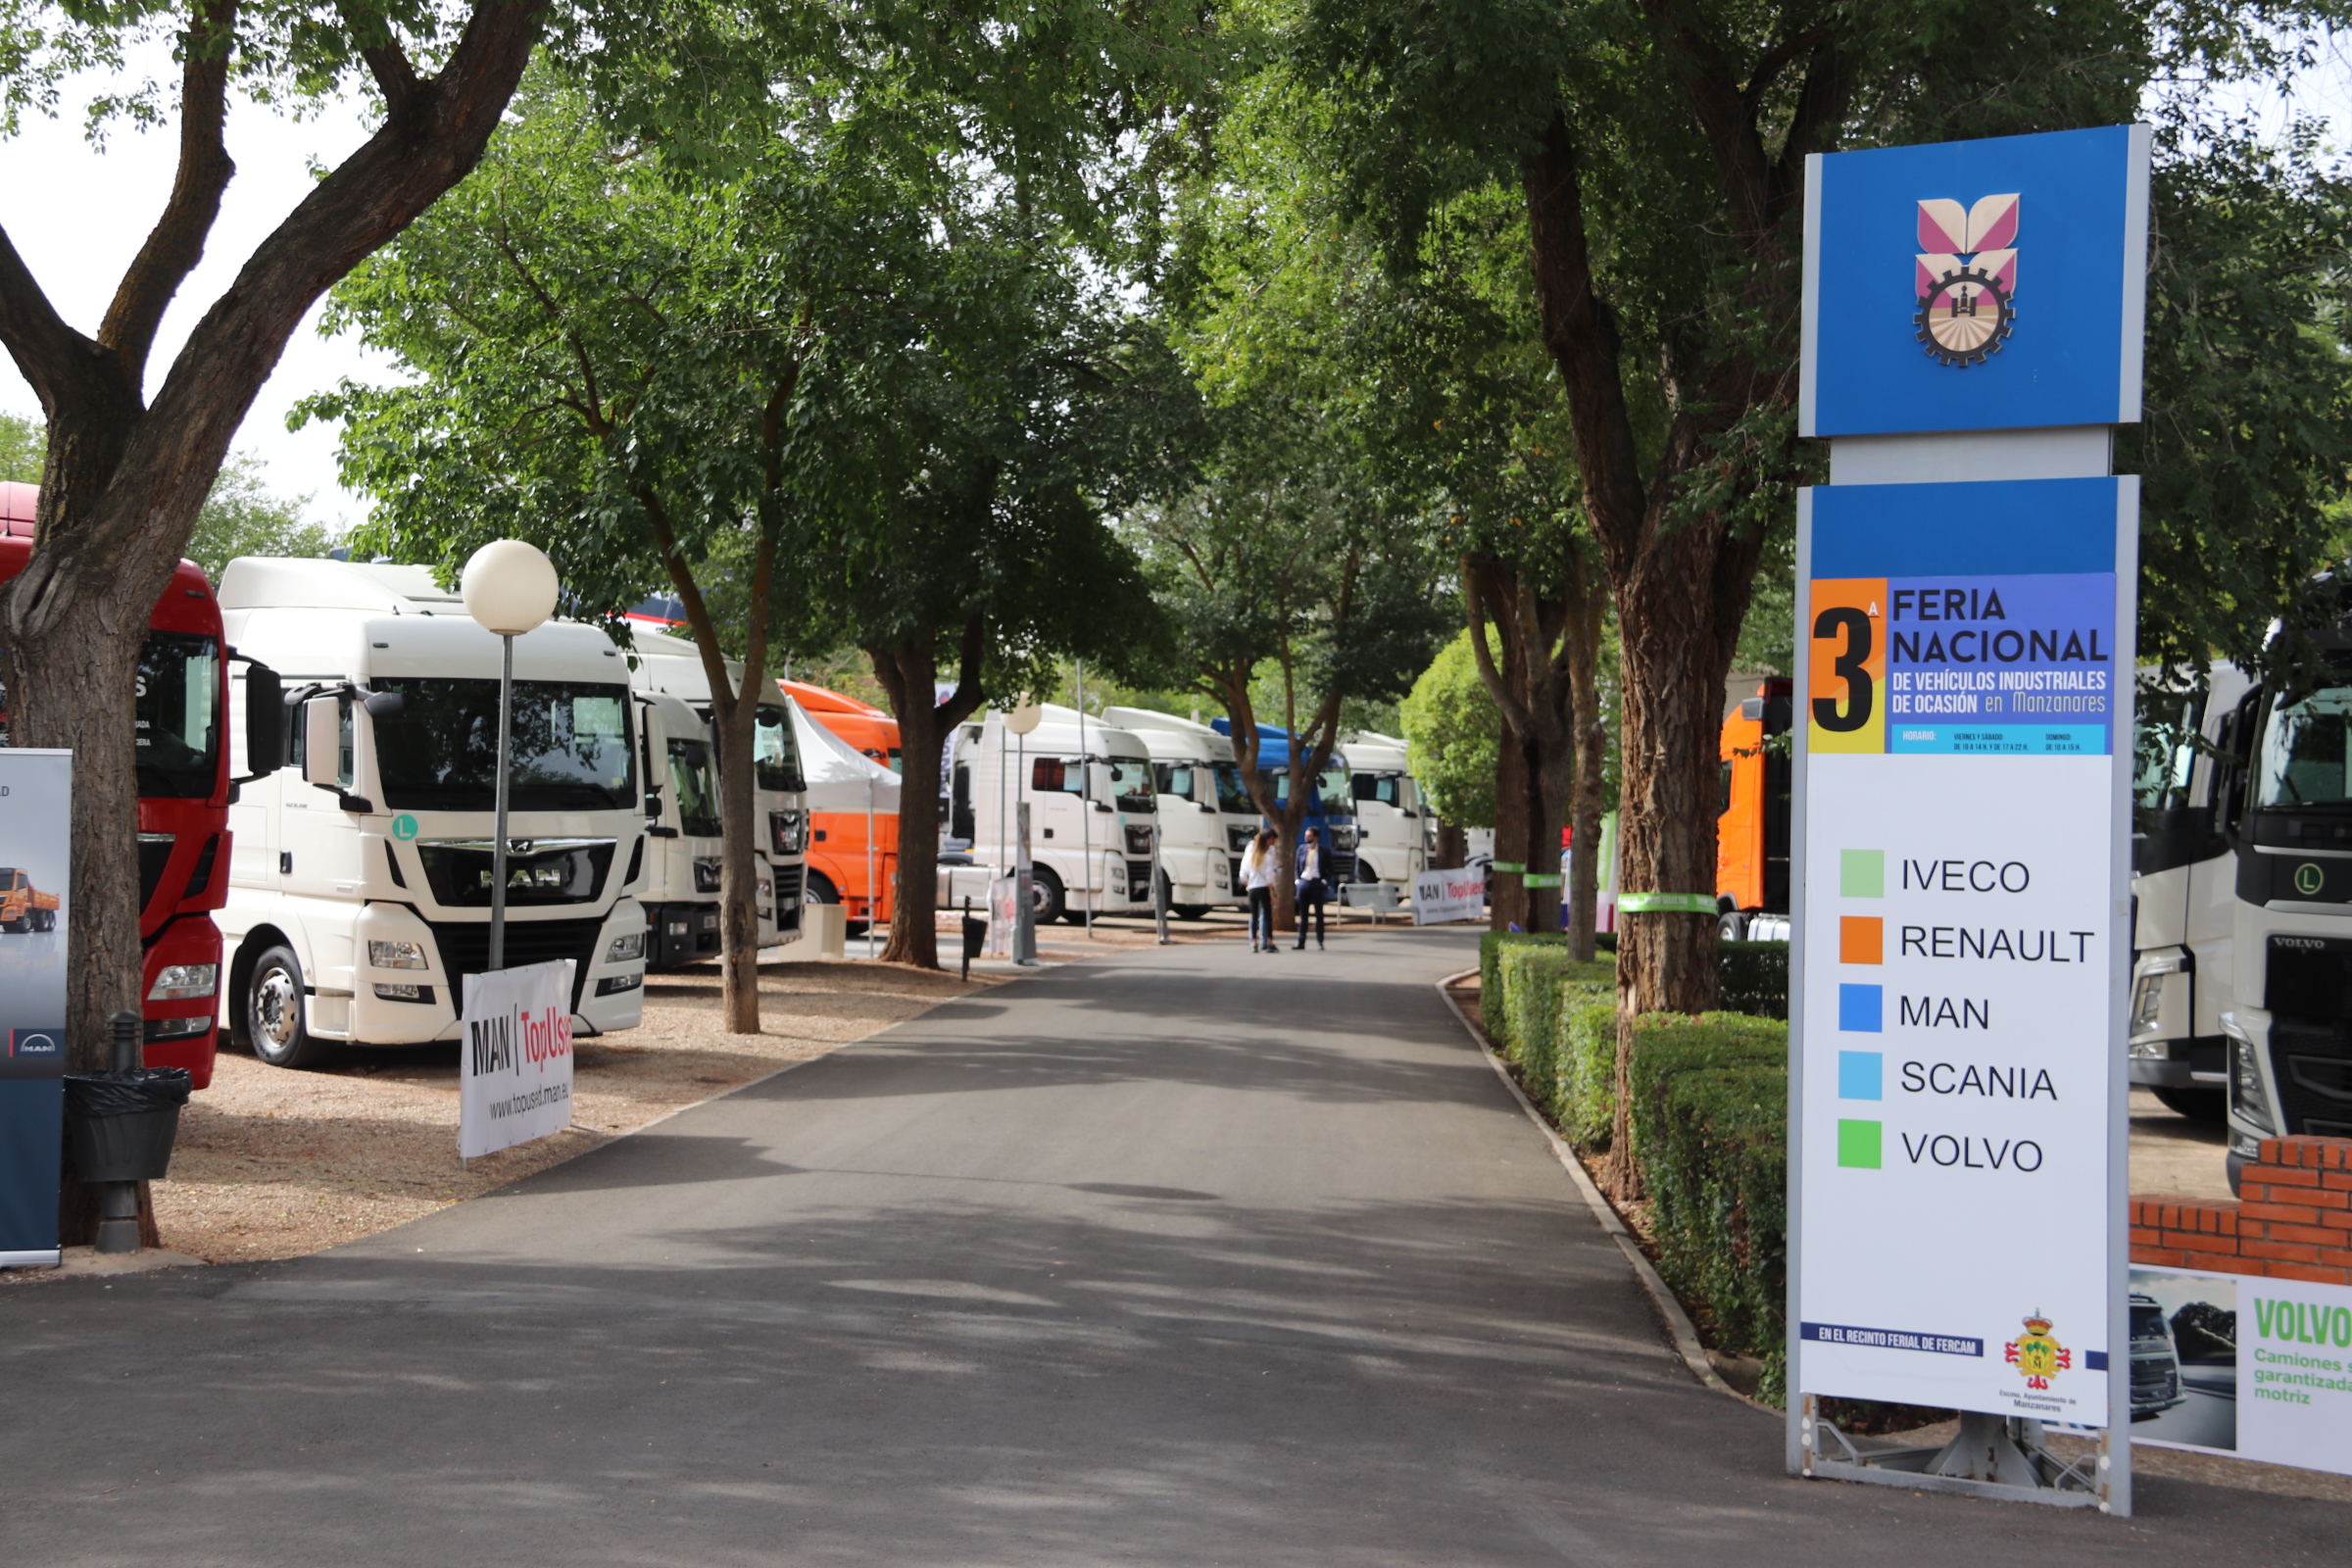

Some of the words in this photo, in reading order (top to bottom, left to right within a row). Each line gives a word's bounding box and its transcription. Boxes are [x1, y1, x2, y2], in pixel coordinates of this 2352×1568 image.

[1893, 588, 2006, 621] FERIA
[1892, 628, 2109, 662] NACIONAL
[1892, 672, 1911, 691] DE
[1915, 668, 1995, 691] VEHÍCULOS
[1999, 670, 2106, 691] INDUSTRIALES
[1892, 694, 1911, 713] DE
[1914, 691, 1978, 713] OCASIÓN
[1984, 695, 2003, 712] en
[2012, 691, 2106, 712] Manzanares
[1902, 730, 1936, 741] HORARIO:
[400, 818, 412, 837] L
[1902, 859, 2031, 893] IVECO
[2303, 869, 2315, 889] L
[1901, 925, 2095, 963] RENAULT
[2274, 937, 2326, 949] VOLVO
[1900, 995, 1989, 1030] MAN
[470, 1014, 511, 1077] MAN
[1900, 1060, 2058, 1101] SCANIA
[1901, 1132, 2043, 1172] VOLVO
[2254, 1298, 2352, 1348] VOLVO
[1819, 1327, 1833, 1341] EN
[1834, 1328, 1845, 1342] EL
[1846, 1329, 1886, 1346] RECINTO
[1887, 1333, 1921, 1349] FERIAL
[1922, 1337, 1935, 1350] DE
[1936, 1338, 1977, 1354] FERCAM
[2254, 1348, 2342, 1372] Camiones
[2014, 1398, 2061, 1412] Manzanares
[2255, 1387, 2311, 1405] motriz
